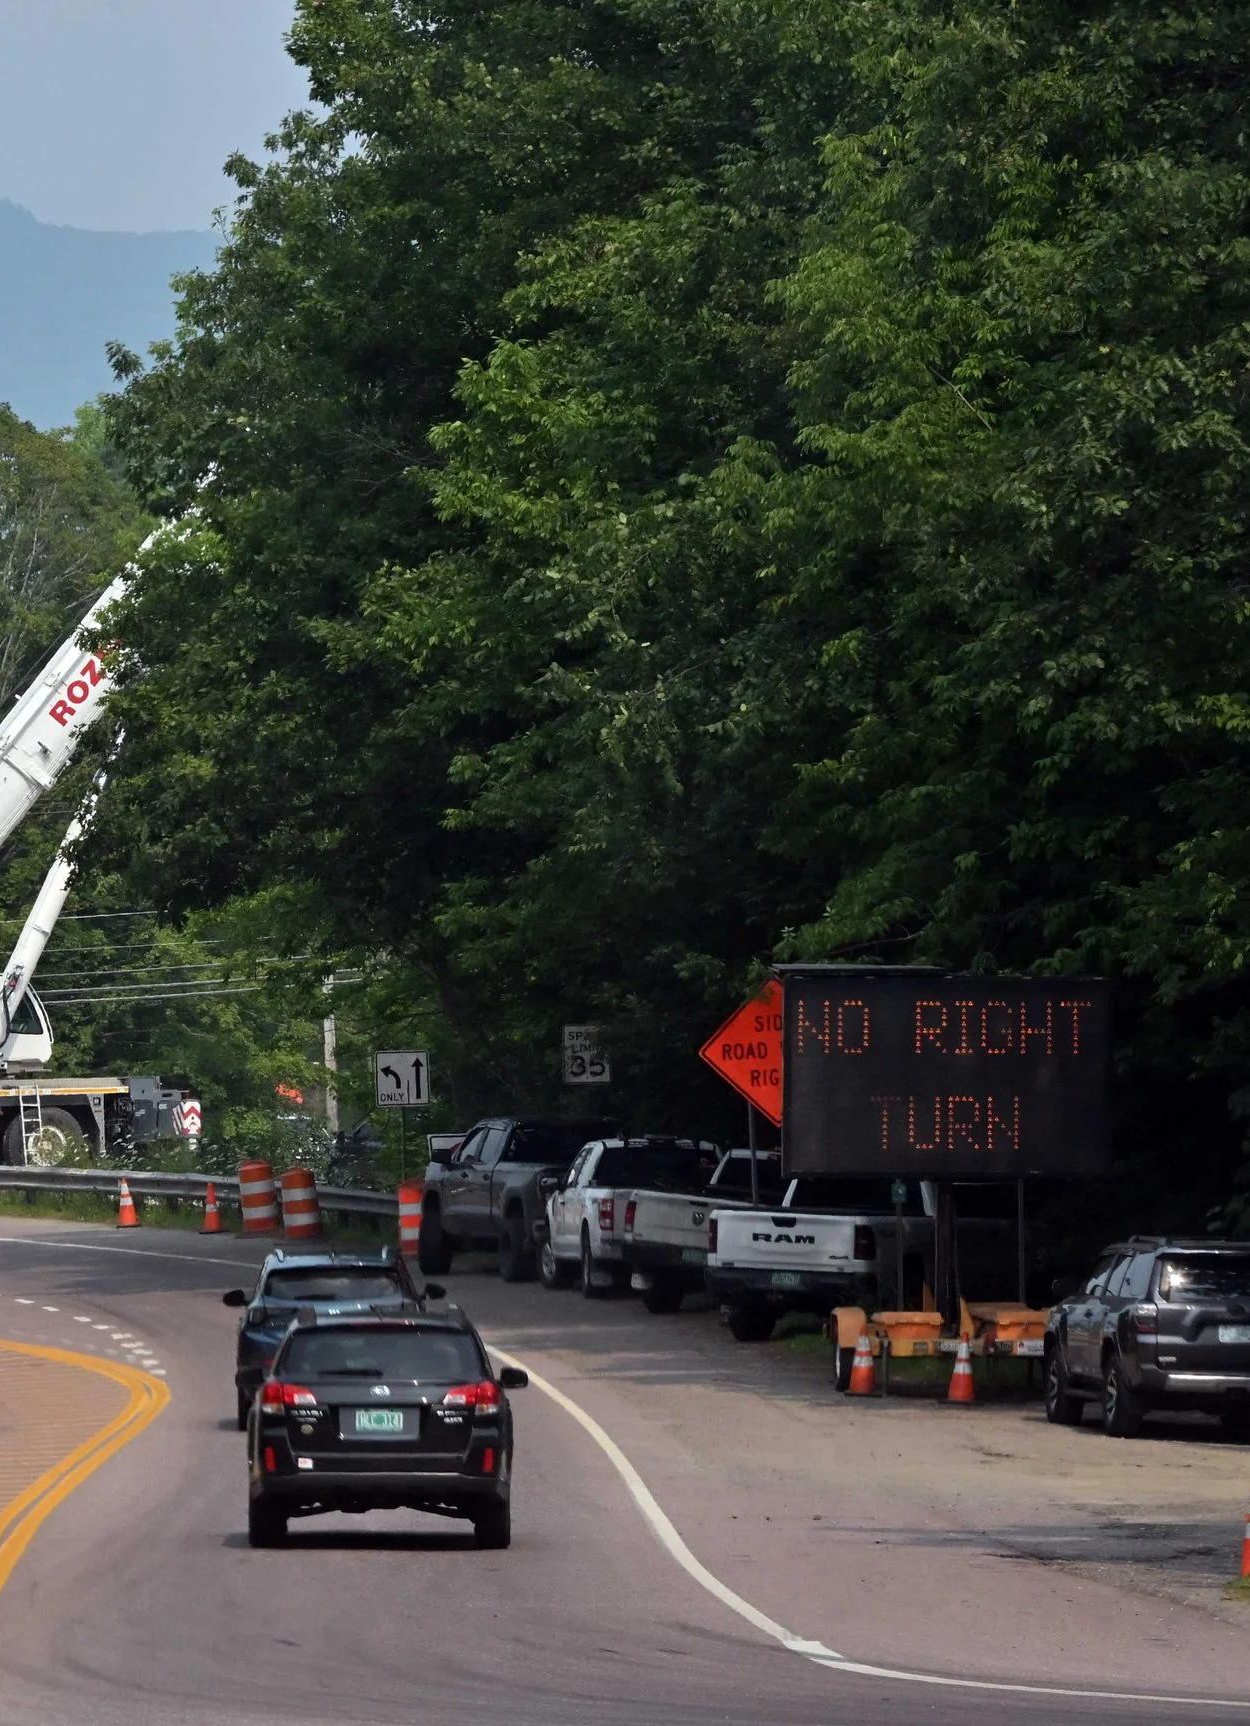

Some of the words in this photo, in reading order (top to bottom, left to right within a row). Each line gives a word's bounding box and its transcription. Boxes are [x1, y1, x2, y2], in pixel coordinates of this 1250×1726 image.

[754, 1014, 783, 1032] SID
[798, 1000, 870, 1053] NO
[915, 1000, 1092, 1054] RIGHT
[722, 1042, 768, 1060] ROAD
[570, 1055, 606, 1077] 35
[751, 1068, 780, 1087] RIG
[380, 1093, 405, 1102] ONLY
[871, 1096, 1020, 1150] TURN
[753, 1233, 815, 1244] RAM
